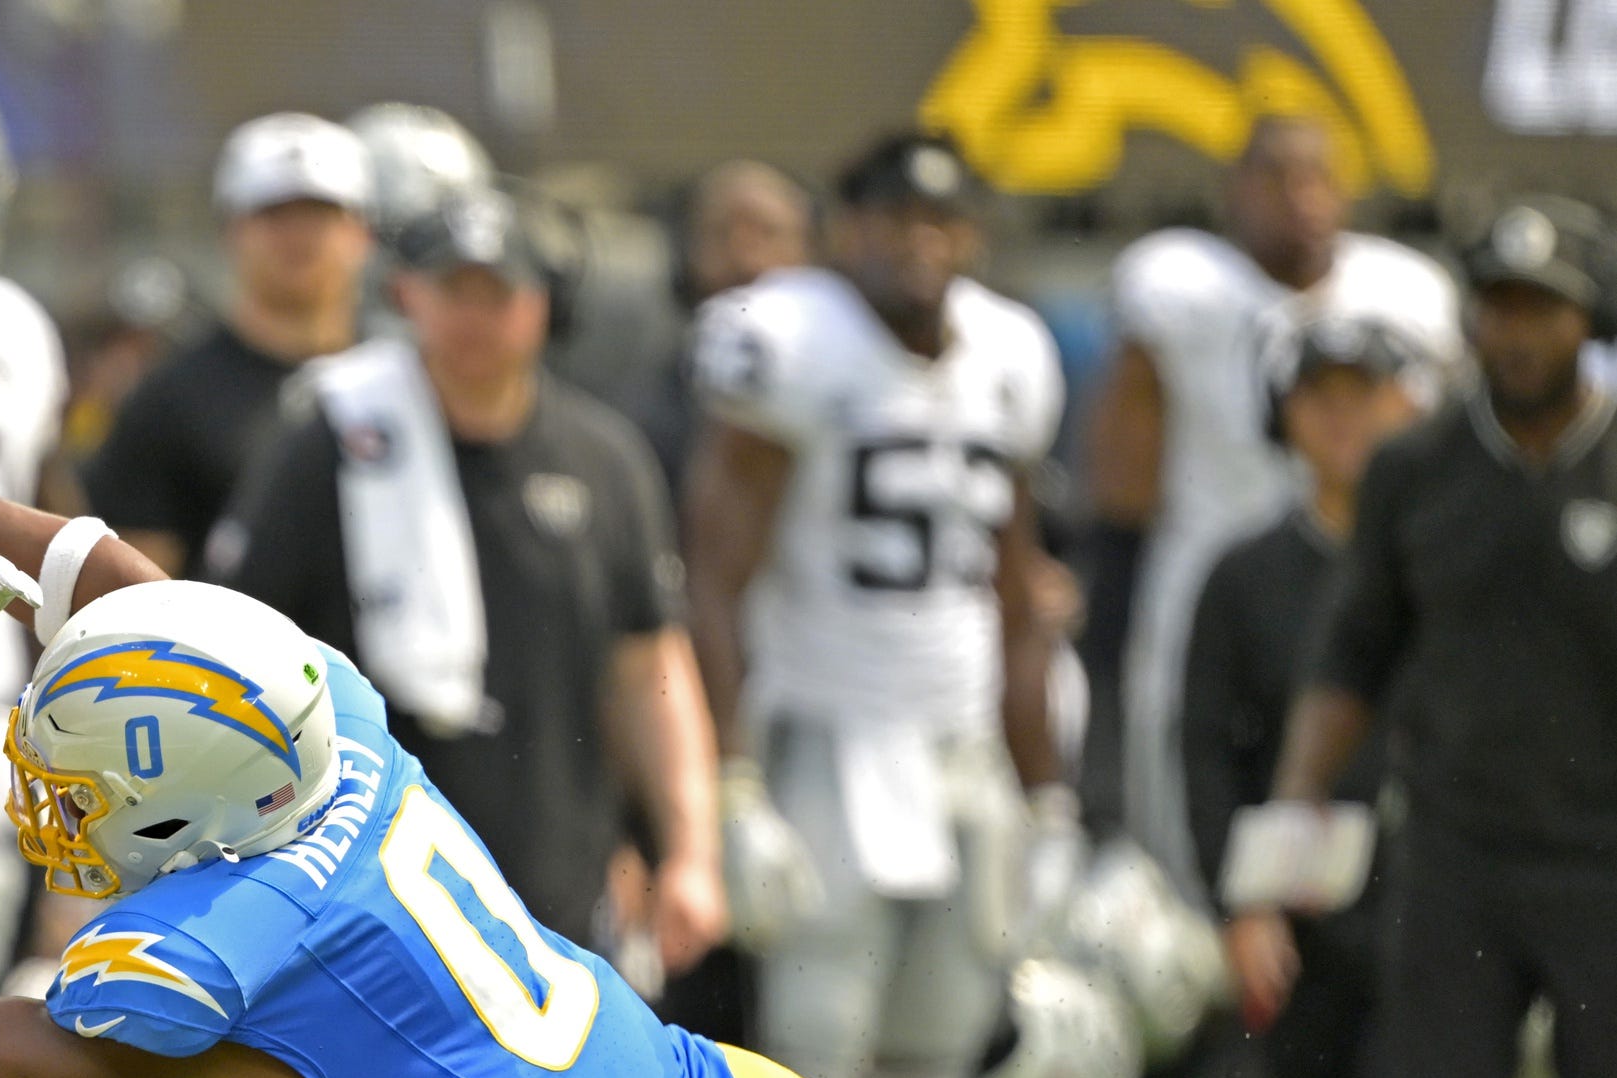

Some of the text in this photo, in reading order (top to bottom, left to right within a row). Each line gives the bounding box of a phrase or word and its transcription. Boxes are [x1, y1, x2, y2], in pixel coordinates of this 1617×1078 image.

[125, 715, 164, 779] 0
[265, 735, 385, 891] HENLEY
[378, 783, 600, 1072] 0
